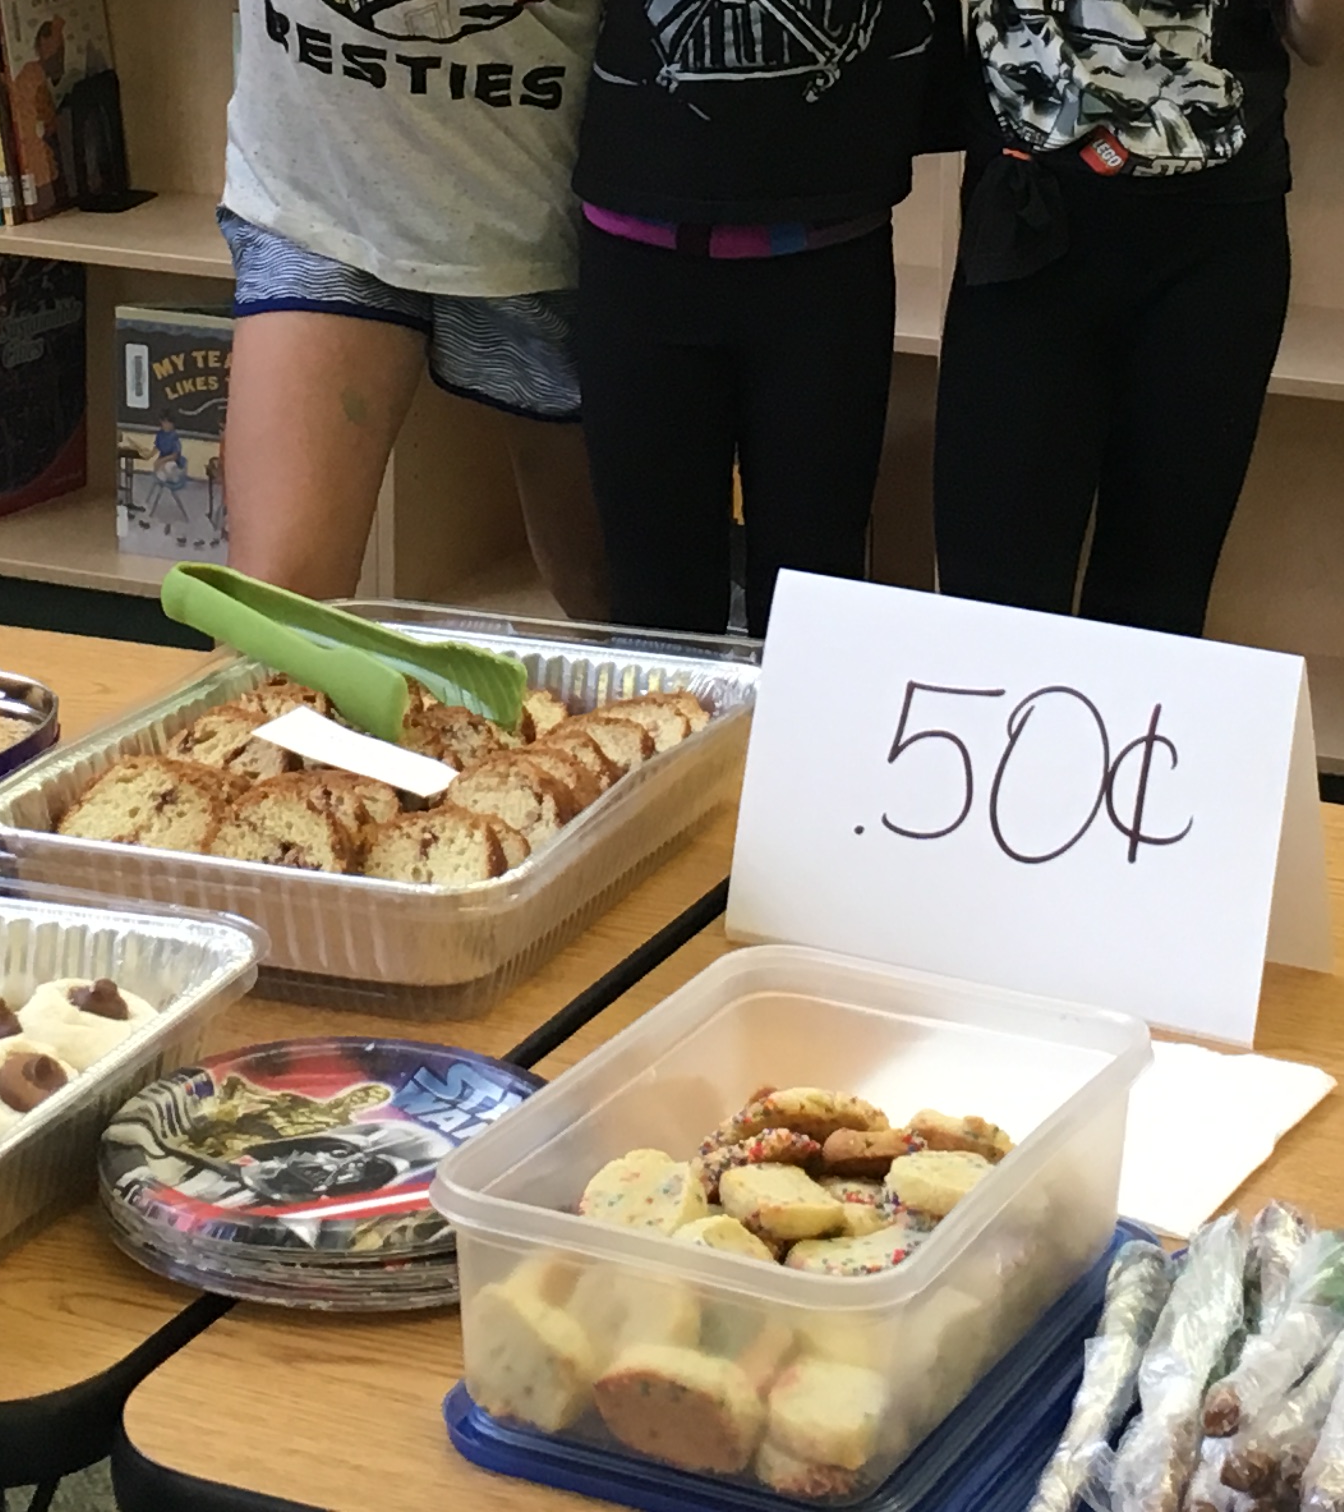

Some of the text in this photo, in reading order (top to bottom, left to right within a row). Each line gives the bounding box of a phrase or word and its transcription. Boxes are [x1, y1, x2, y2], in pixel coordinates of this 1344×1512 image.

[1092, 138, 1123, 168] LEGO
[152, 351, 186, 380] MY
[164, 374, 220, 402] LIKES
[852, 679, 1195, 865] .50¢
